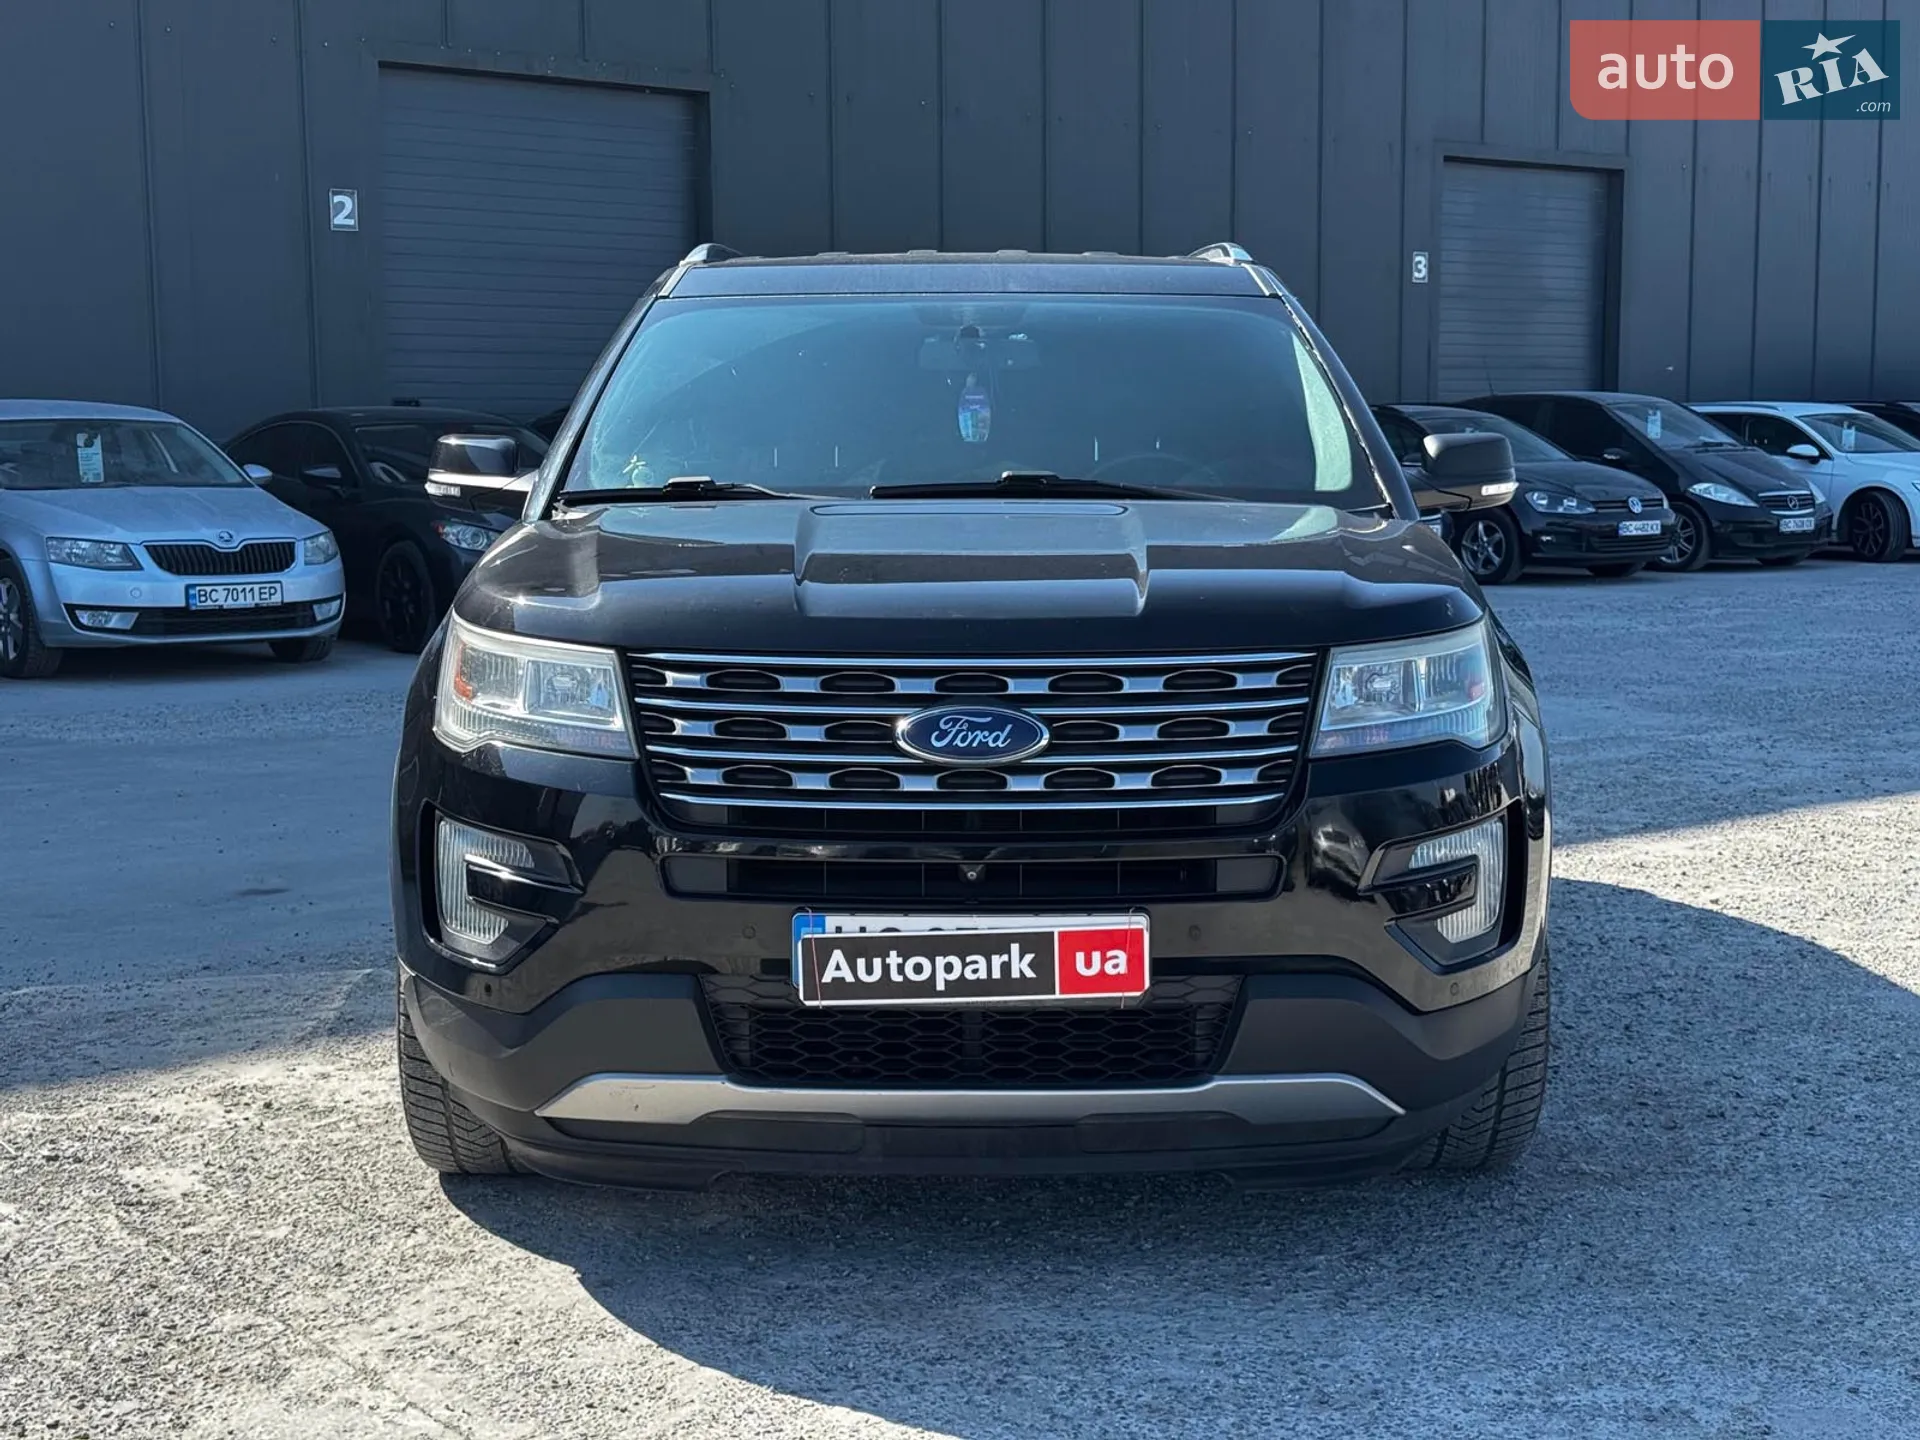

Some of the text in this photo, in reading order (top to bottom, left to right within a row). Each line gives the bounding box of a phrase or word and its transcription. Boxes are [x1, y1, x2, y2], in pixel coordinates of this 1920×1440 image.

[333, 195, 354, 225] 2
[1413, 255, 1426, 278] 3
[197, 586, 277, 603] BC 7011 EP
[930, 715, 1012, 748] Ford
[821, 943, 1128, 991] Autopark ua
